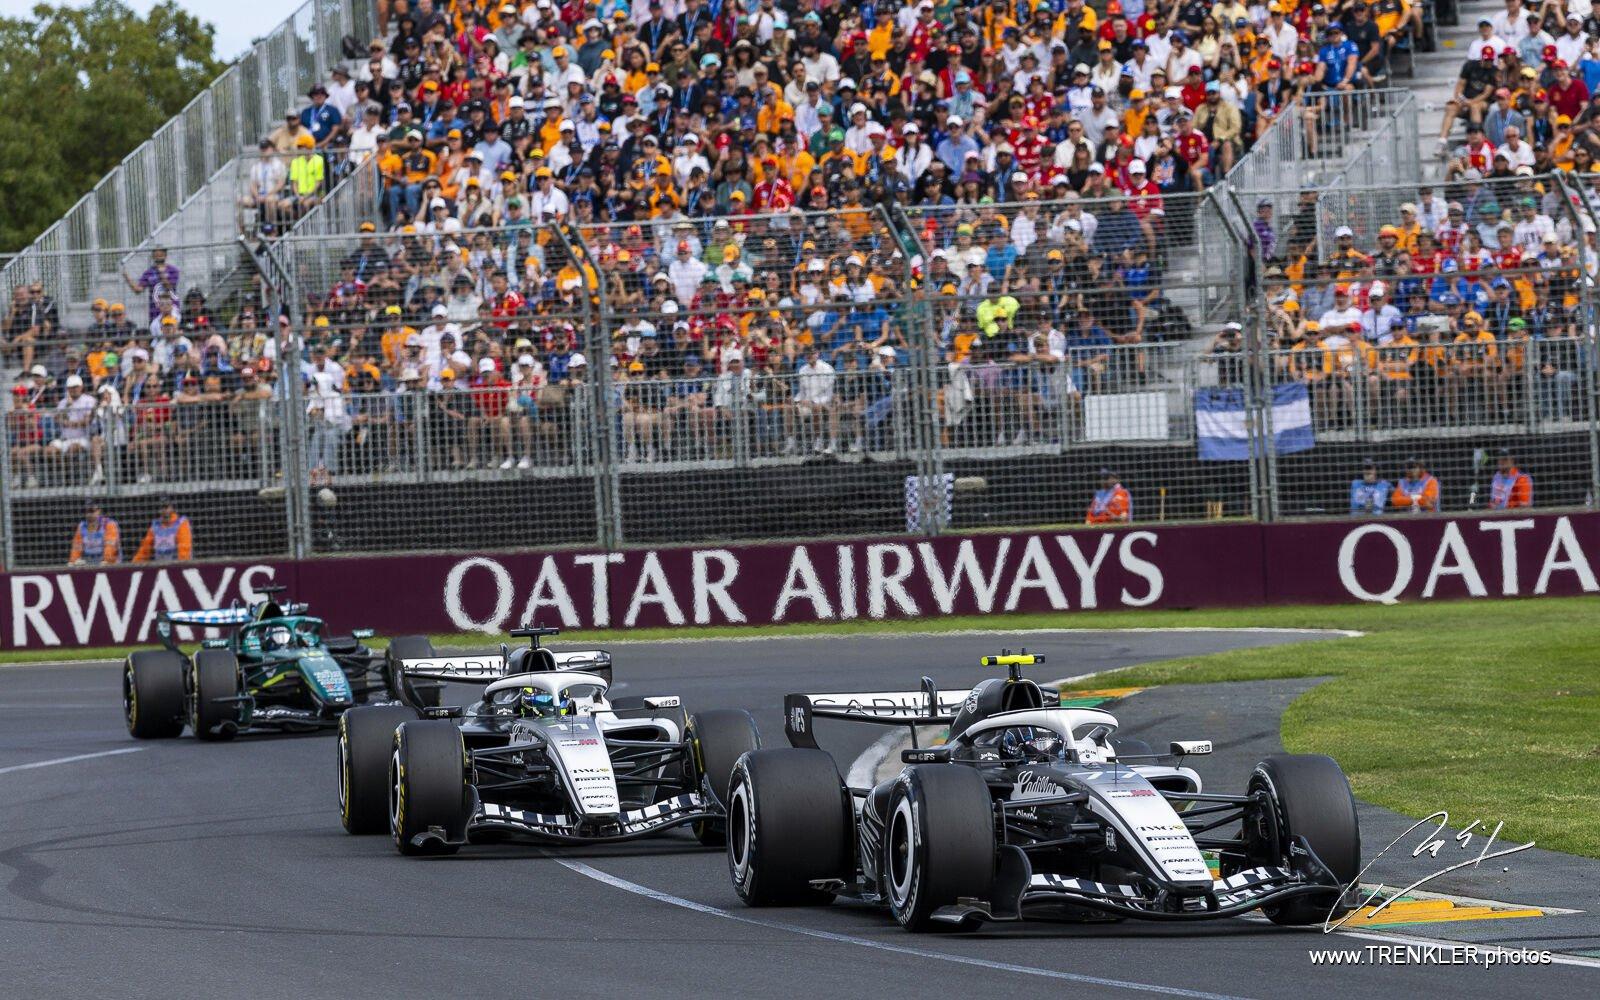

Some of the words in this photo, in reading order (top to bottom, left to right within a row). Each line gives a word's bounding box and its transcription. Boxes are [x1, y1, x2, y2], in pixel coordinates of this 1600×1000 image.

[444, 549, 747, 635] QATAR
[772, 531, 1164, 622] AIRWAYS
[1338, 516, 1600, 605] QATA
[1017, 771, 1058, 795] Cadillac
